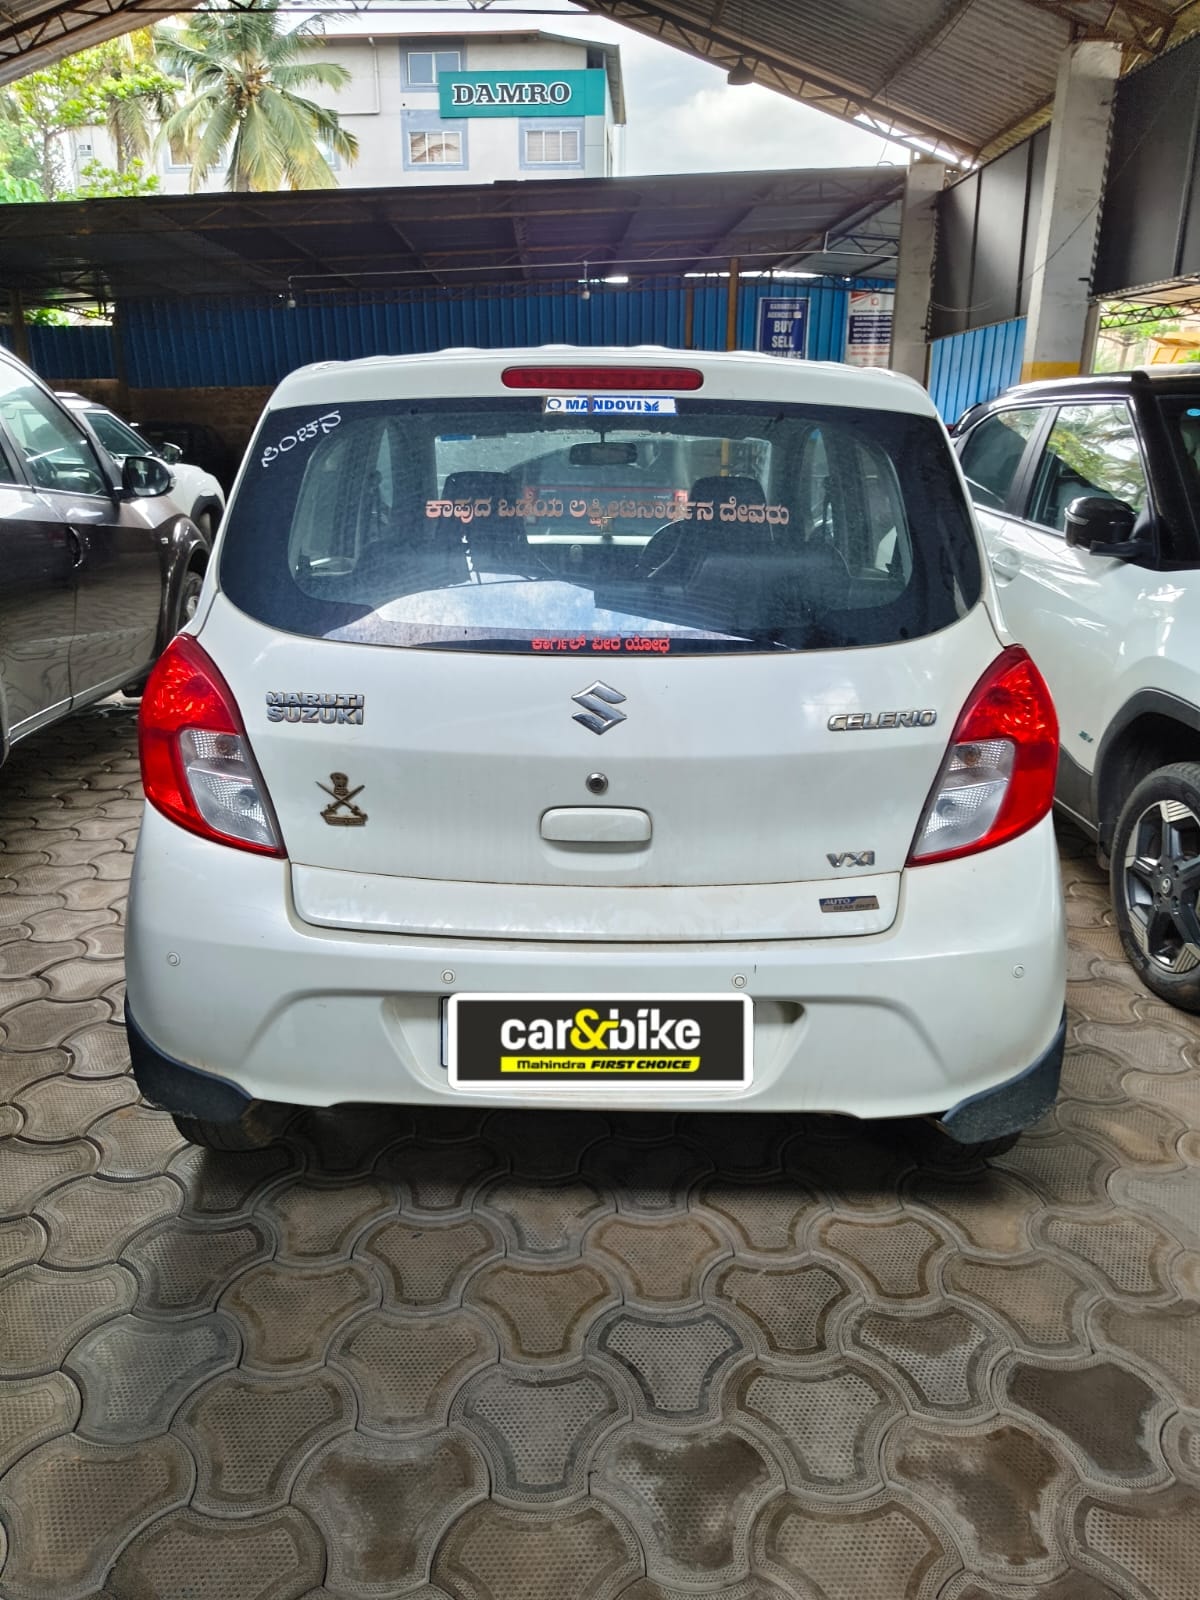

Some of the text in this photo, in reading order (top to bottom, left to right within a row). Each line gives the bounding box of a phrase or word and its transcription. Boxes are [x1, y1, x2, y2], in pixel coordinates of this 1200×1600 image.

[452, 82, 572, 105] DAMRO
[773, 320, 794, 333] BUY
[771, 335, 795, 348] SELL
[565, 399, 642, 411] MANDOVI
[719, 495, 790, 526] ದೇವರು
[265, 691, 365, 706] MARUTI
[266, 705, 364, 725] SUZUKI
[827, 709, 938, 731] CELERIO
[824, 897, 851, 906] AUTO
